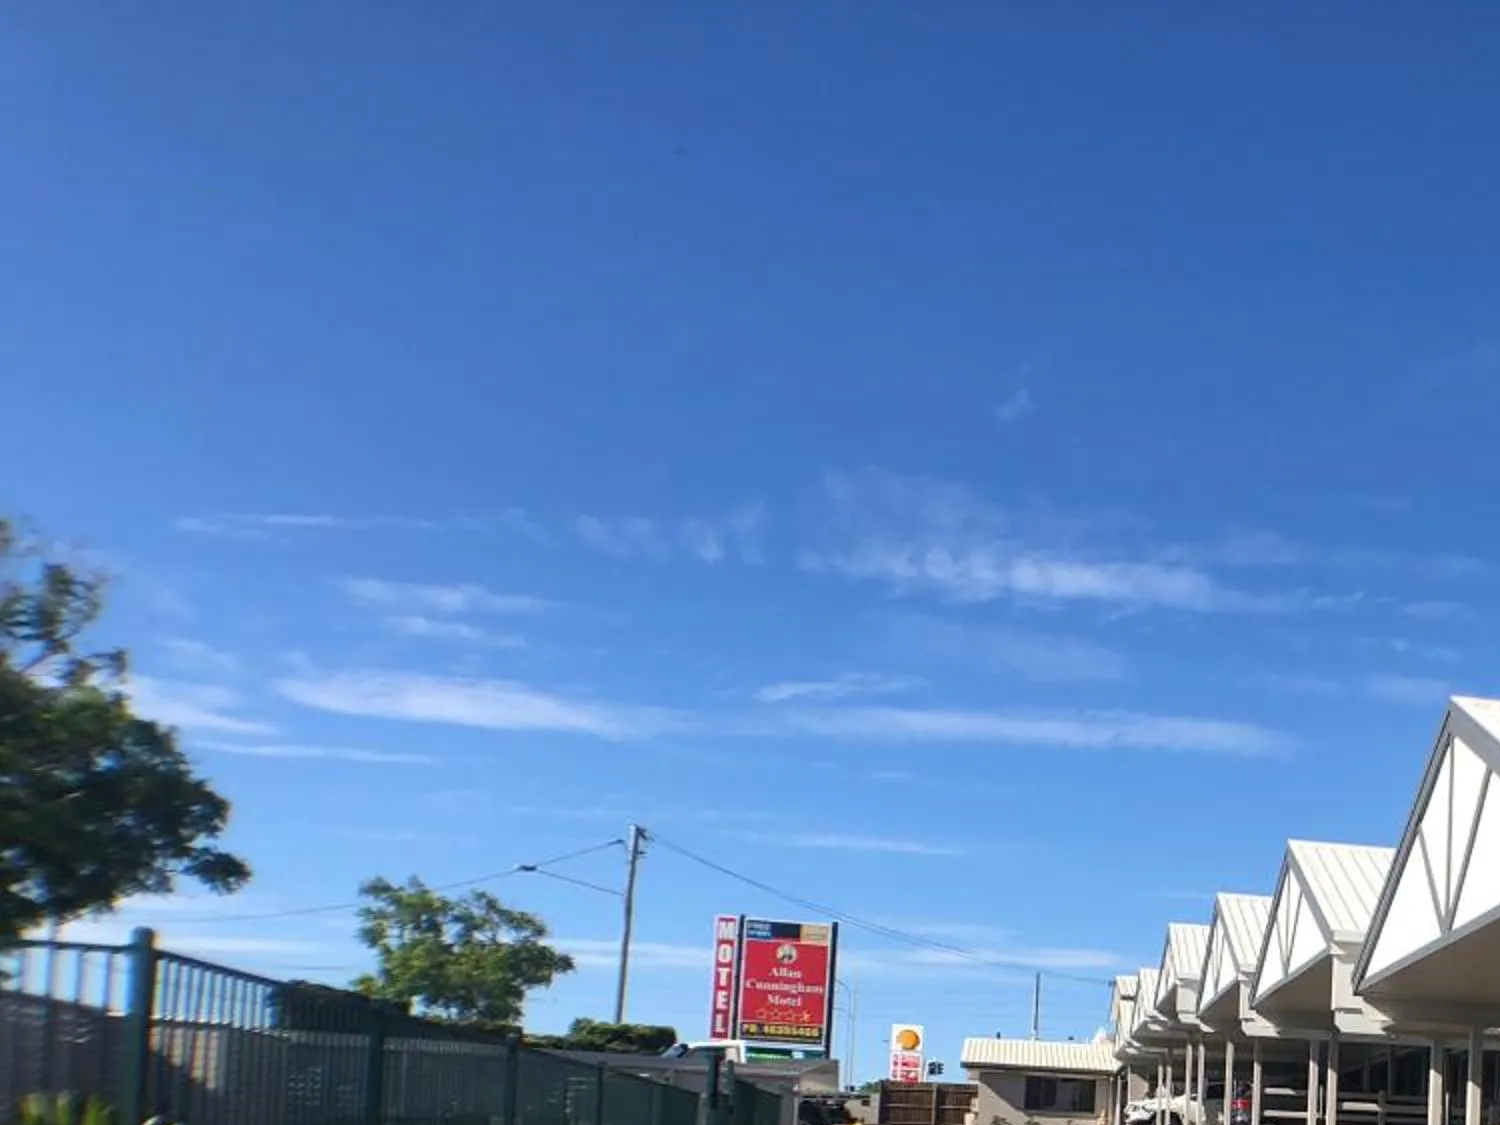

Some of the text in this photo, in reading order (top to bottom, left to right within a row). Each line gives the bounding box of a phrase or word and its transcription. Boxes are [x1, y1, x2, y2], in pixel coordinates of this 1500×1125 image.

[715, 919, 736, 1033] MOTEL
[769, 967, 802, 978] Allan
[746, 978, 823, 994] Cunningham
[768, 993, 801, 1007] Motel
